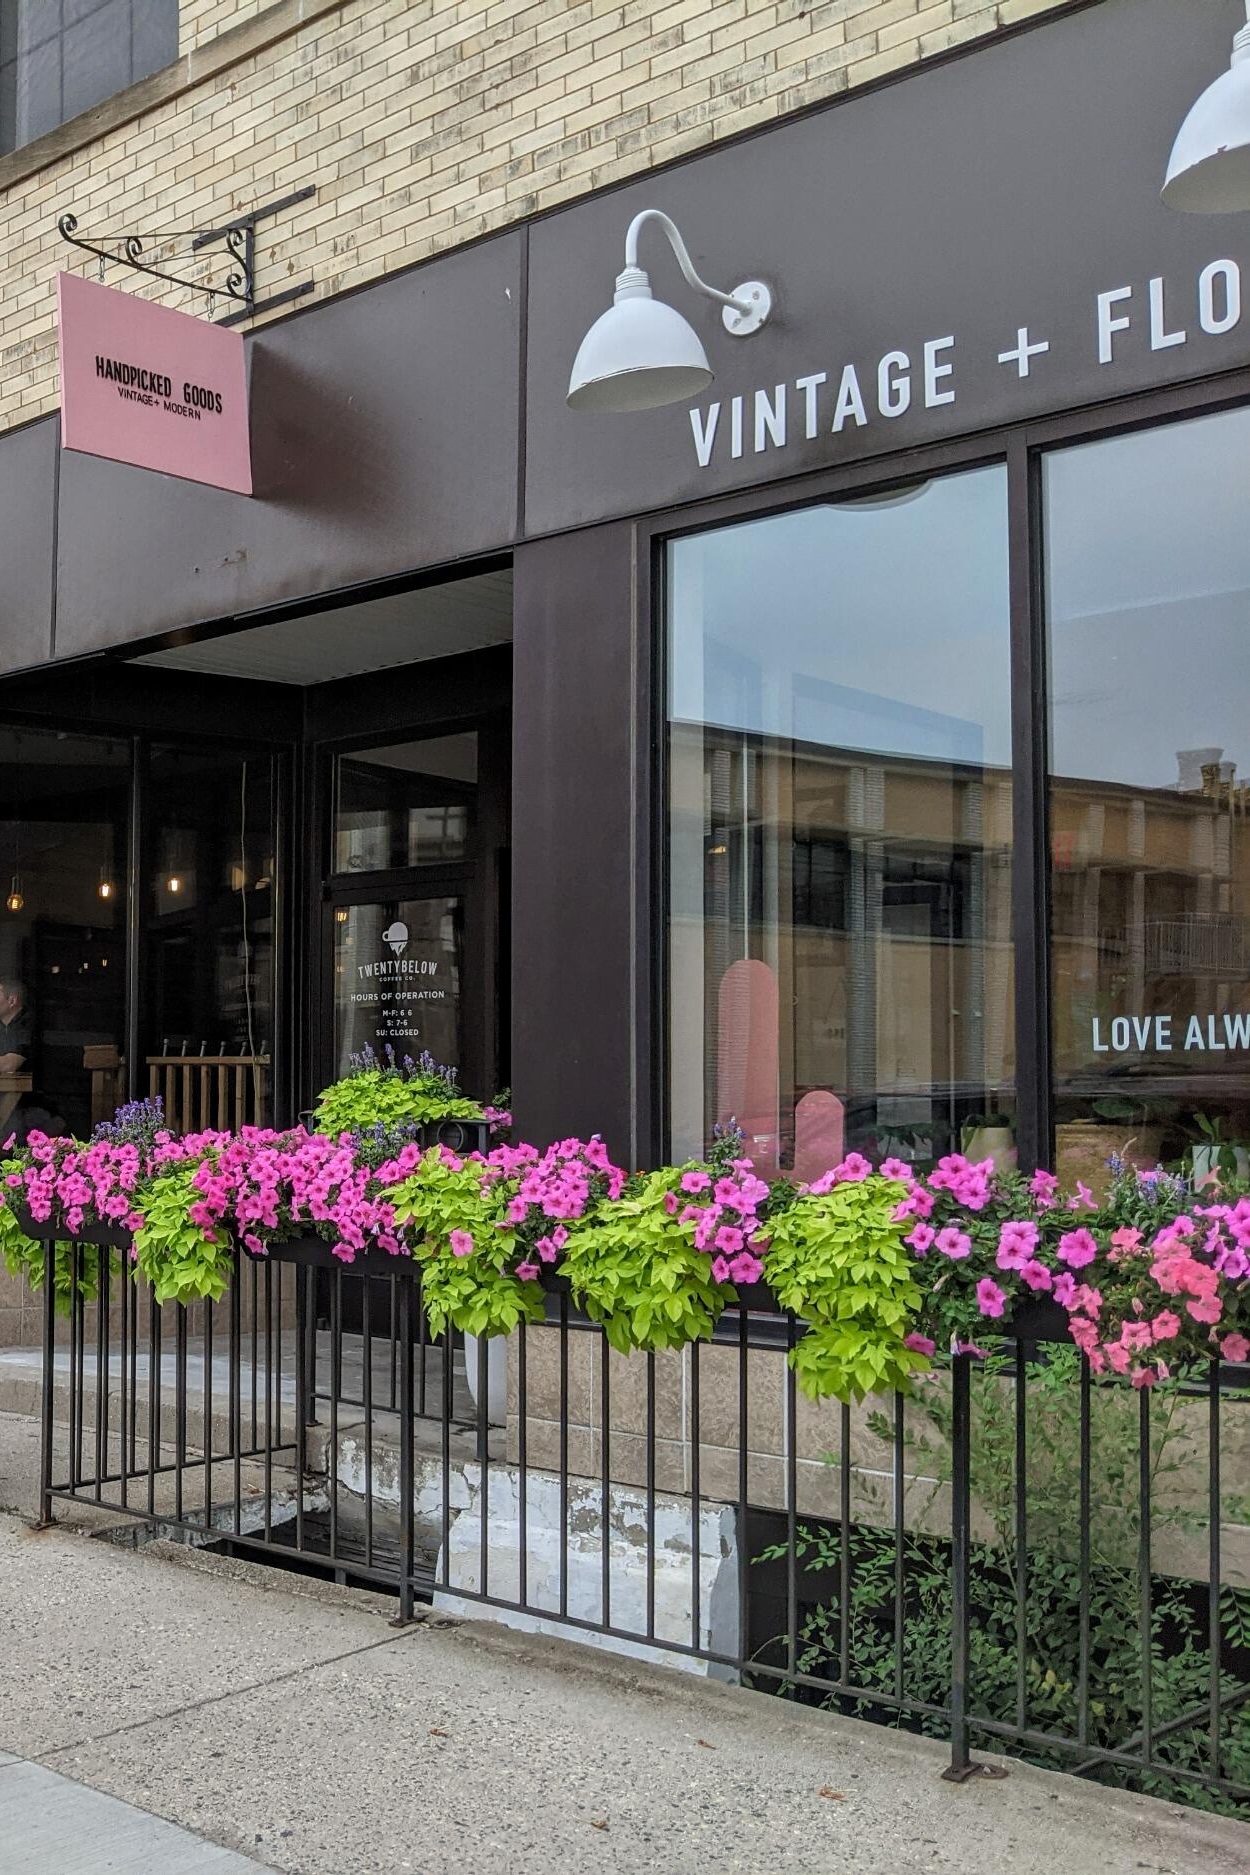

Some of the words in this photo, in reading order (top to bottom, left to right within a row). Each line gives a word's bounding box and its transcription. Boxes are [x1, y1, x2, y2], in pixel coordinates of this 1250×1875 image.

[689, 335, 956, 467] VINTAGE
[1097, 258, 1241, 365] FLO
[95, 355, 172, 398] HANDPICKED
[183, 382, 223, 414] GOODS
[163, 401, 201, 421] MODERN
[357, 959, 438, 979] TWENTYBELOW
[350, 993, 379, 1002] HOURS
[381, 992, 393, 1000] OF
[395, 990, 445, 1000] OPERATION
[390, 1028, 419, 1036] CLOSED
[1092, 1015, 1172, 1051] LOVE
[1183, 1013, 1250, 1051] ALW
